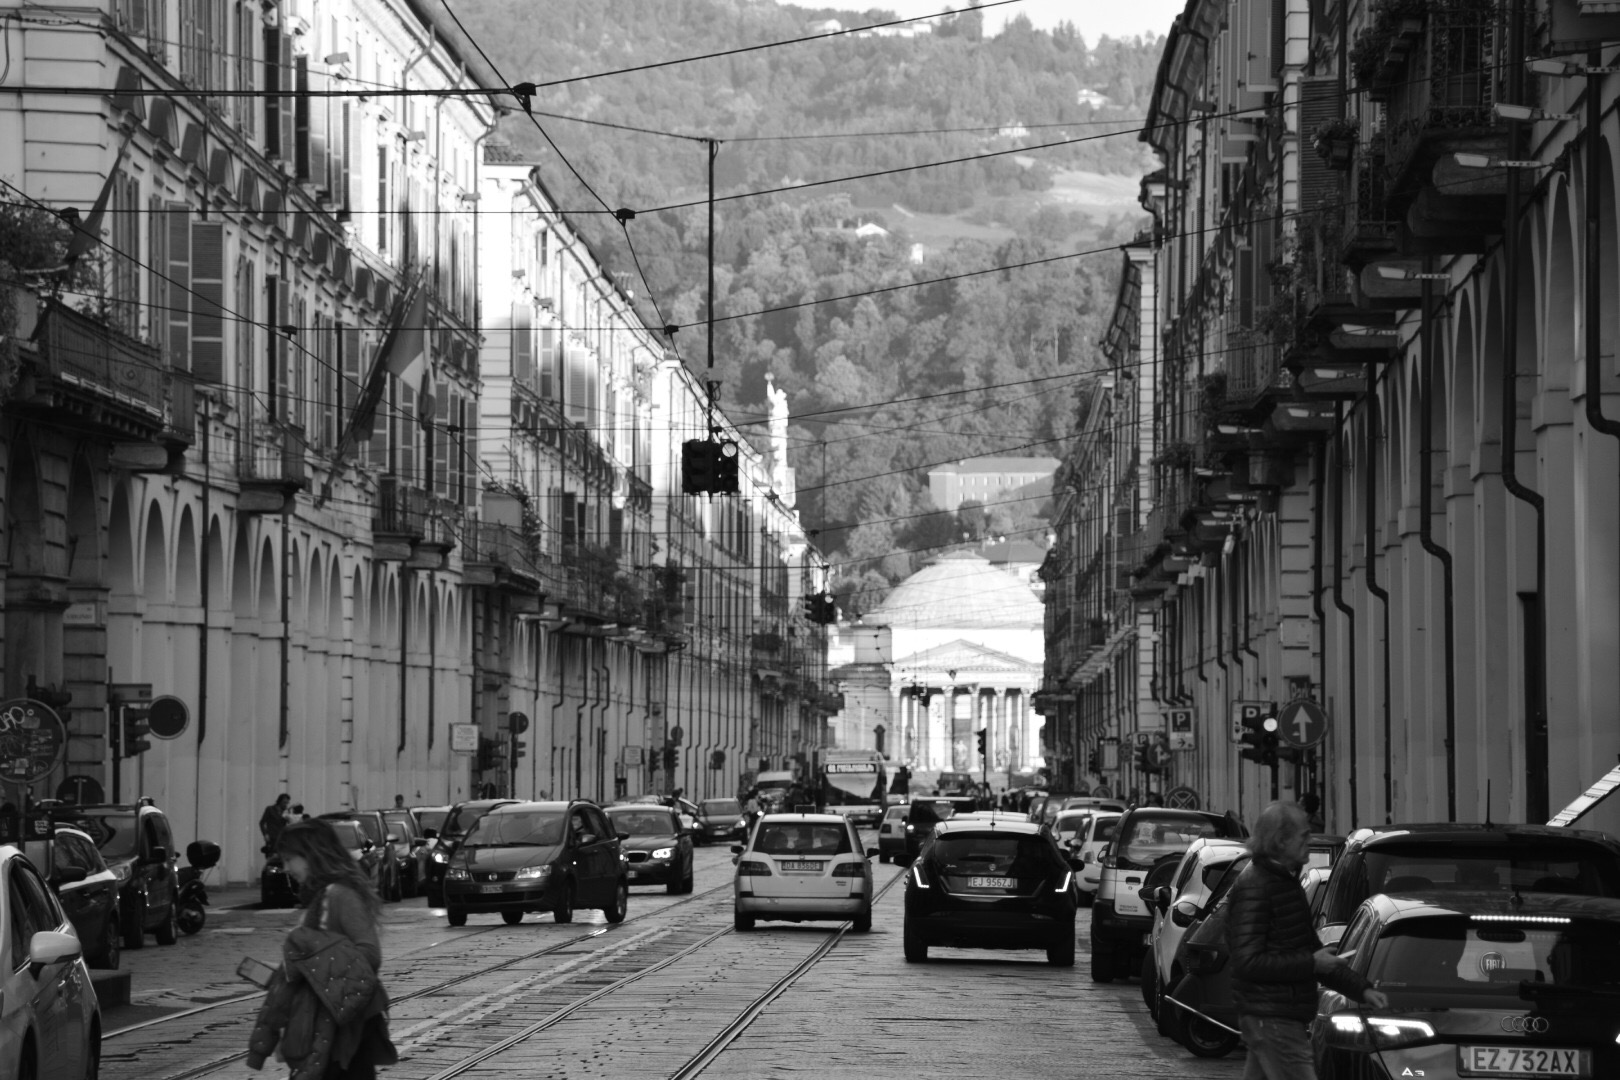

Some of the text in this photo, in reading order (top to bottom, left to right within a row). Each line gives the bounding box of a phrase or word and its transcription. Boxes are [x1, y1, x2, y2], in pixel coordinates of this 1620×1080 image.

[1176, 713, 1186, 726] P
[973, 878, 1013, 887] EJ 956ZJ
[1485, 958, 1501, 971] FIAT
[1473, 1048, 1576, 1073] EZ 732AX
[1401, 1066, 1425, 1077] A3
